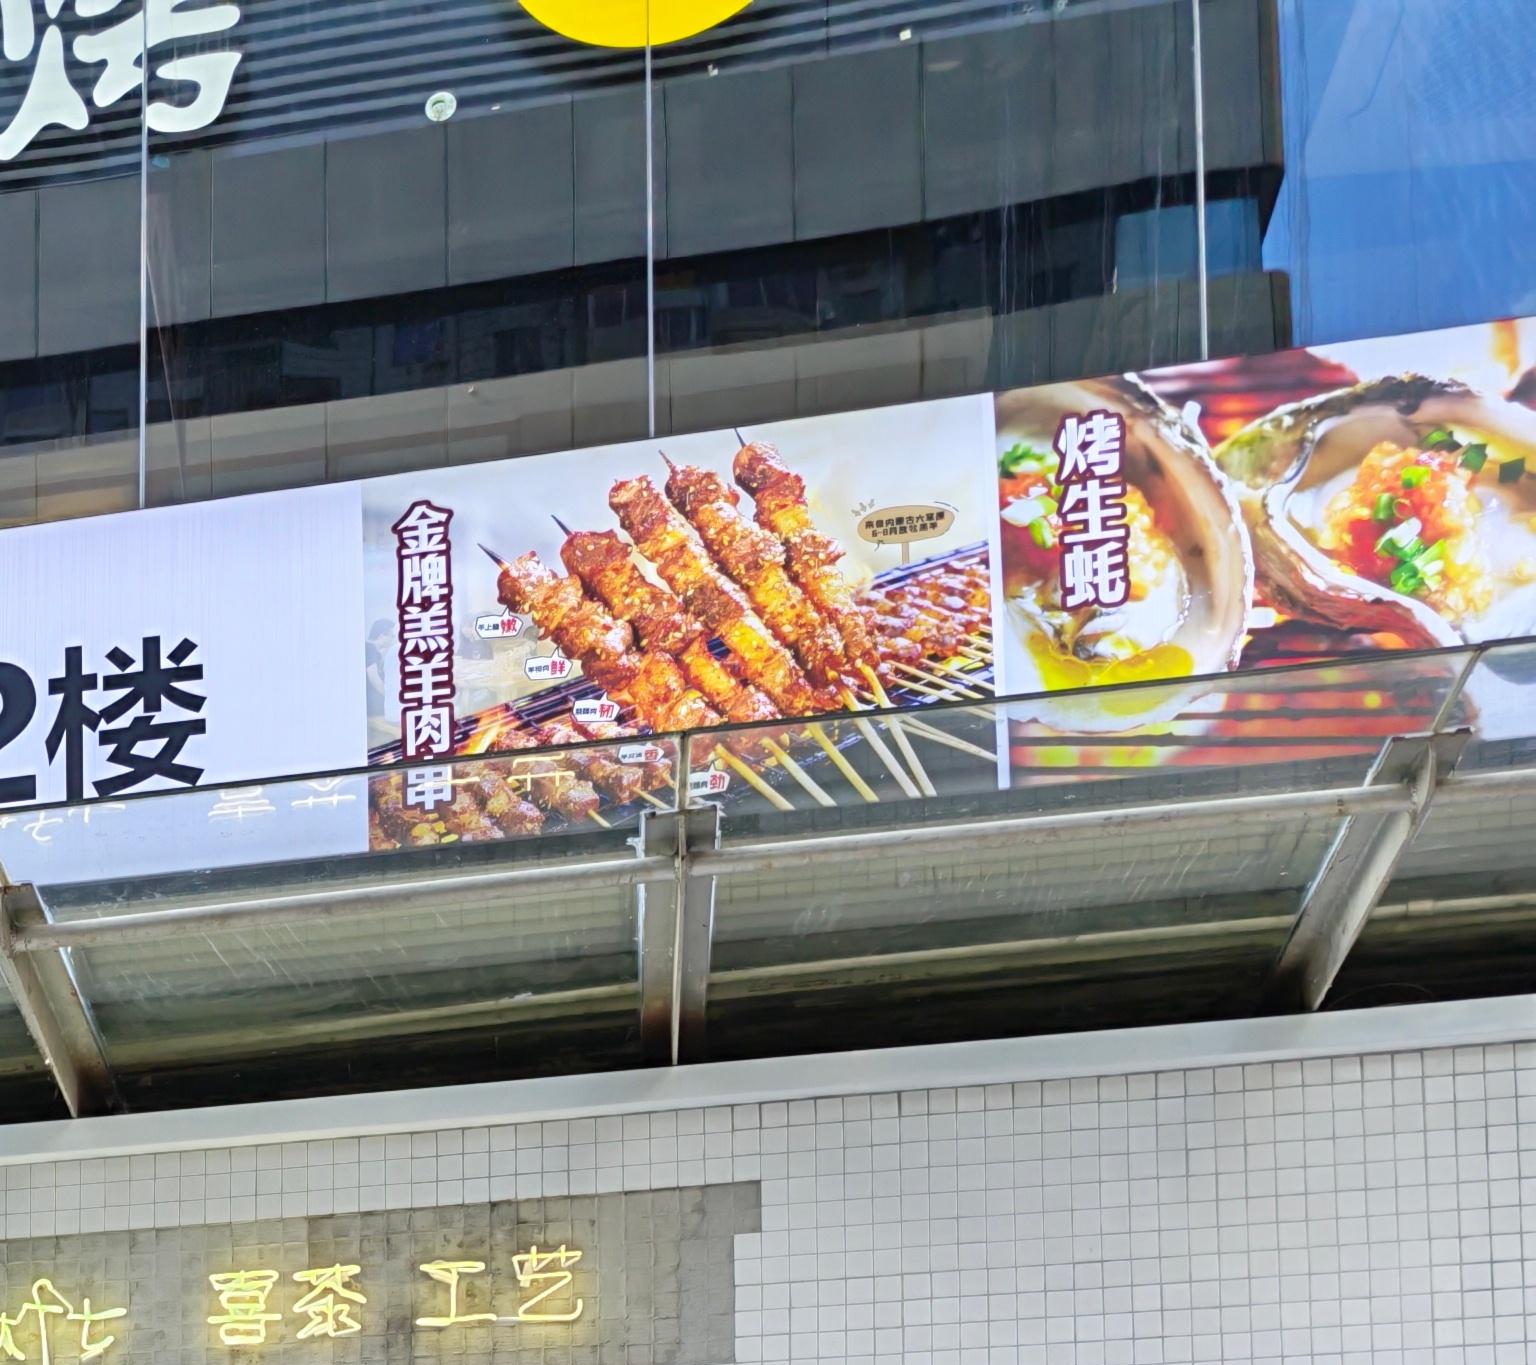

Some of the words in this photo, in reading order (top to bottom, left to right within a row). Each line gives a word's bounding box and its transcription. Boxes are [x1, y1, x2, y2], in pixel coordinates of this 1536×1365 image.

[1057, 408, 1128, 612] 烤生蚝
[391, 498, 460, 816] 金牌羔羊肉串
[550, 659, 566, 676] 鲜
